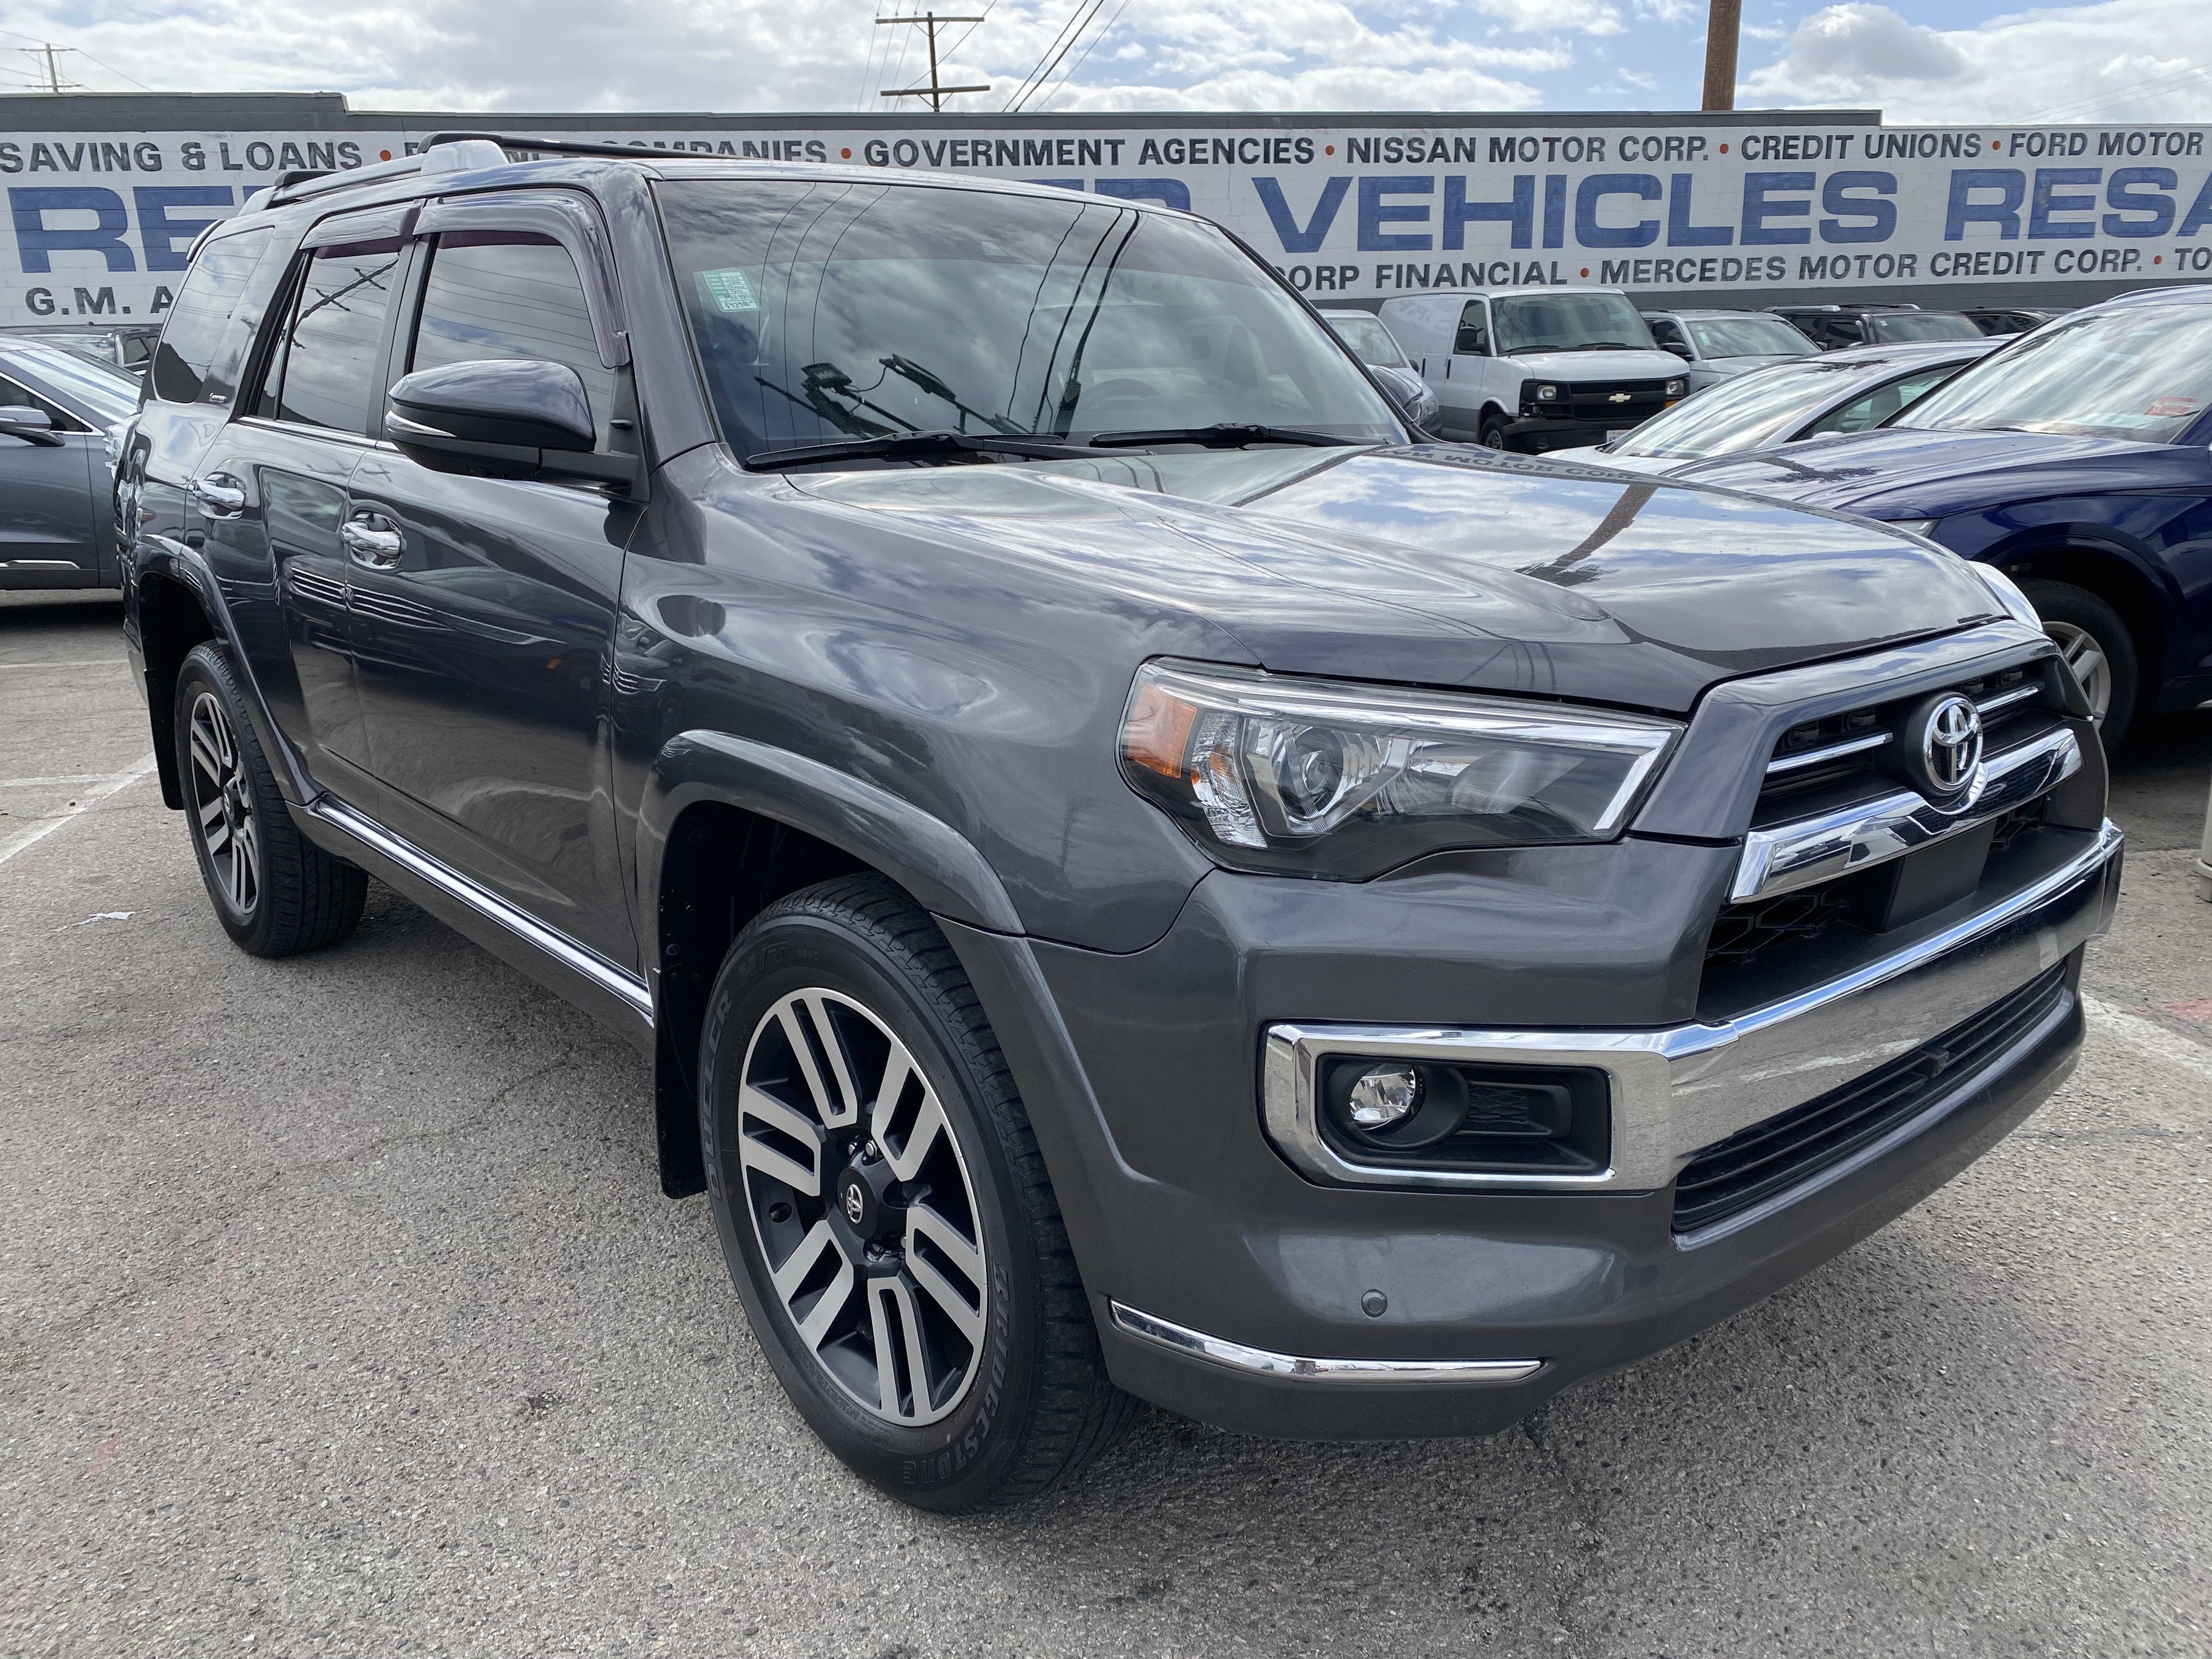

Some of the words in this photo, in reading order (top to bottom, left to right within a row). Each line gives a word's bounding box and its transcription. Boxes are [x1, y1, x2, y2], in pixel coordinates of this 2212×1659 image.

[0, 142, 162, 172] SAVING
[181, 142, 206, 170] &
[219, 141, 363, 171] LOANS
[864, 138, 1125, 167] GOVERNMENT
[1138, 137, 1314, 166] AGENCIES
[1347, 137, 1476, 164] NISSAN
[1489, 136, 1605, 163] MOTOR
[1619, 135, 1709, 162] CORP.
[1741, 134, 1854, 160] CREDIT
[1865, 133, 1982, 159] UNIONS
[2009, 132, 2088, 157] FORD
[2098, 131, 2203, 156] MOTOR
[1251, 171, 1898, 253] VEHICLES
[1274, 265, 1361, 292] ORP
[1375, 260, 1568, 289] FINANCIAL
[1600, 255, 1786, 284] MERCEDES
[1798, 252, 1917, 280] MOTOR
[1930, 249, 2046, 276] CREDIT
[2054, 247, 2143, 274] CORP.
[702, 989, 733, 1200] DUELER
[902, 1259, 1010, 1485] BRIDGESTONE
